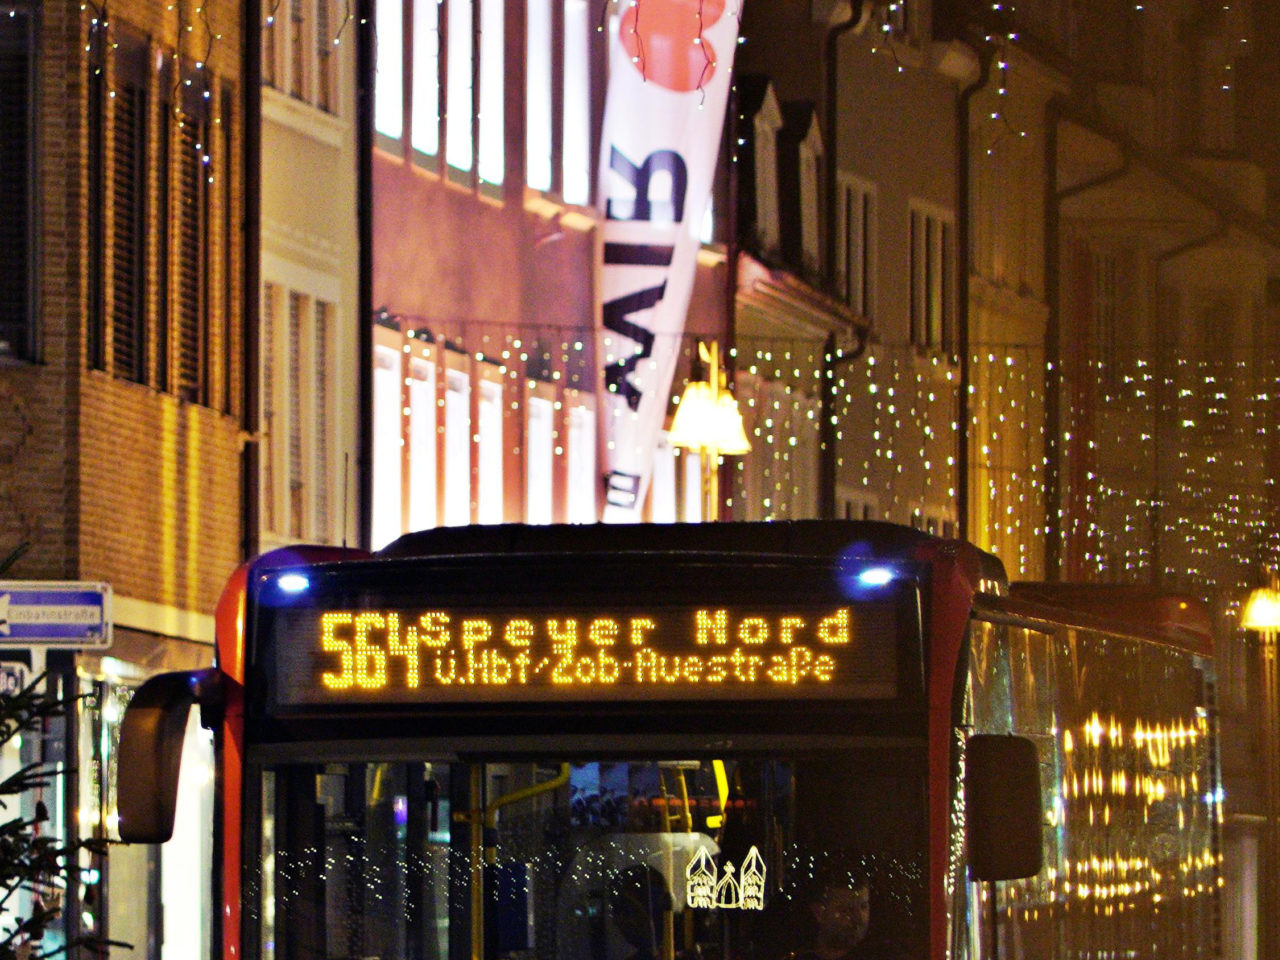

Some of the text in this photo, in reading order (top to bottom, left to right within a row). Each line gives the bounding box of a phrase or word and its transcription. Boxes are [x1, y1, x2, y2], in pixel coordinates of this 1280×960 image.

[321, 608, 849, 688] 564 Speyer Nord
